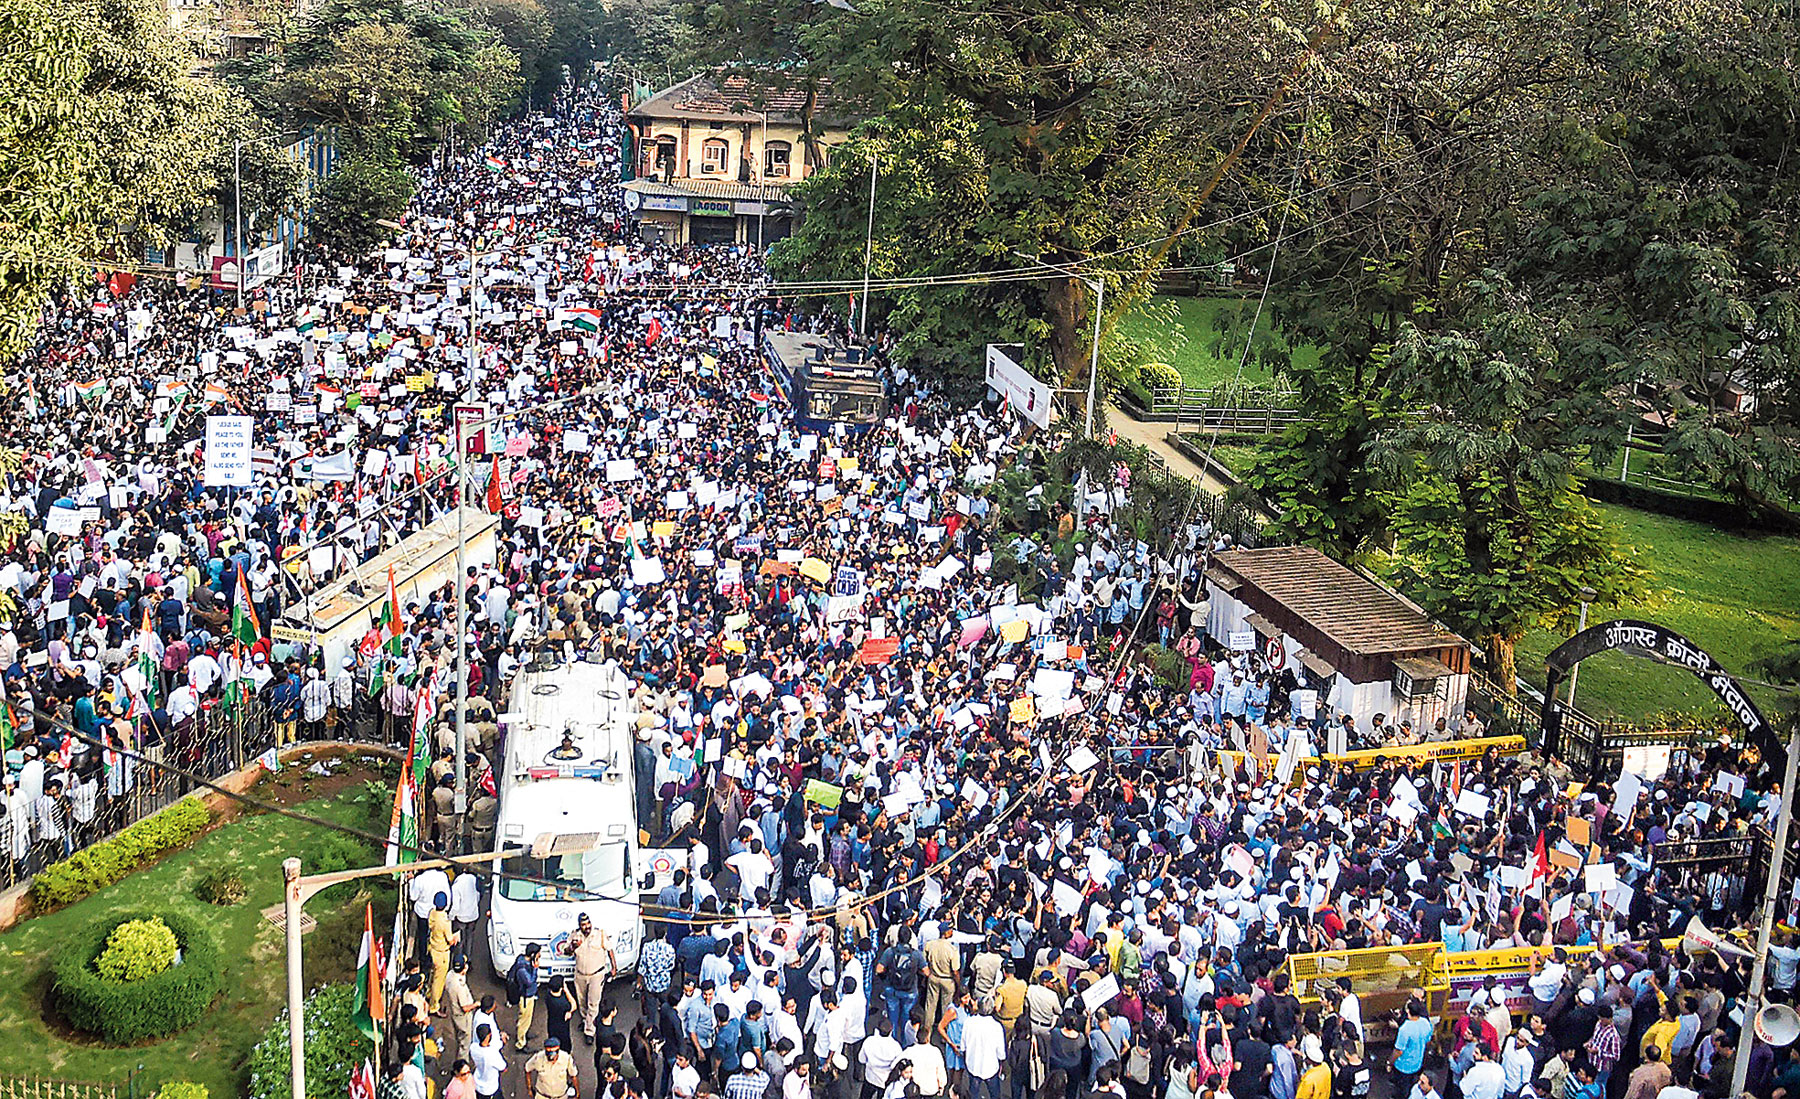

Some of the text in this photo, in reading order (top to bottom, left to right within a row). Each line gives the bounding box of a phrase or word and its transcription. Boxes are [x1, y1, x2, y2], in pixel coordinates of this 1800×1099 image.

[693, 200, 730, 211] LAGOON
[603, 498, 616, 508] NO
[1605, 620, 1657, 647] ऑगस्ट
[1427, 742, 1523, 758] MUMBAI OLICE
